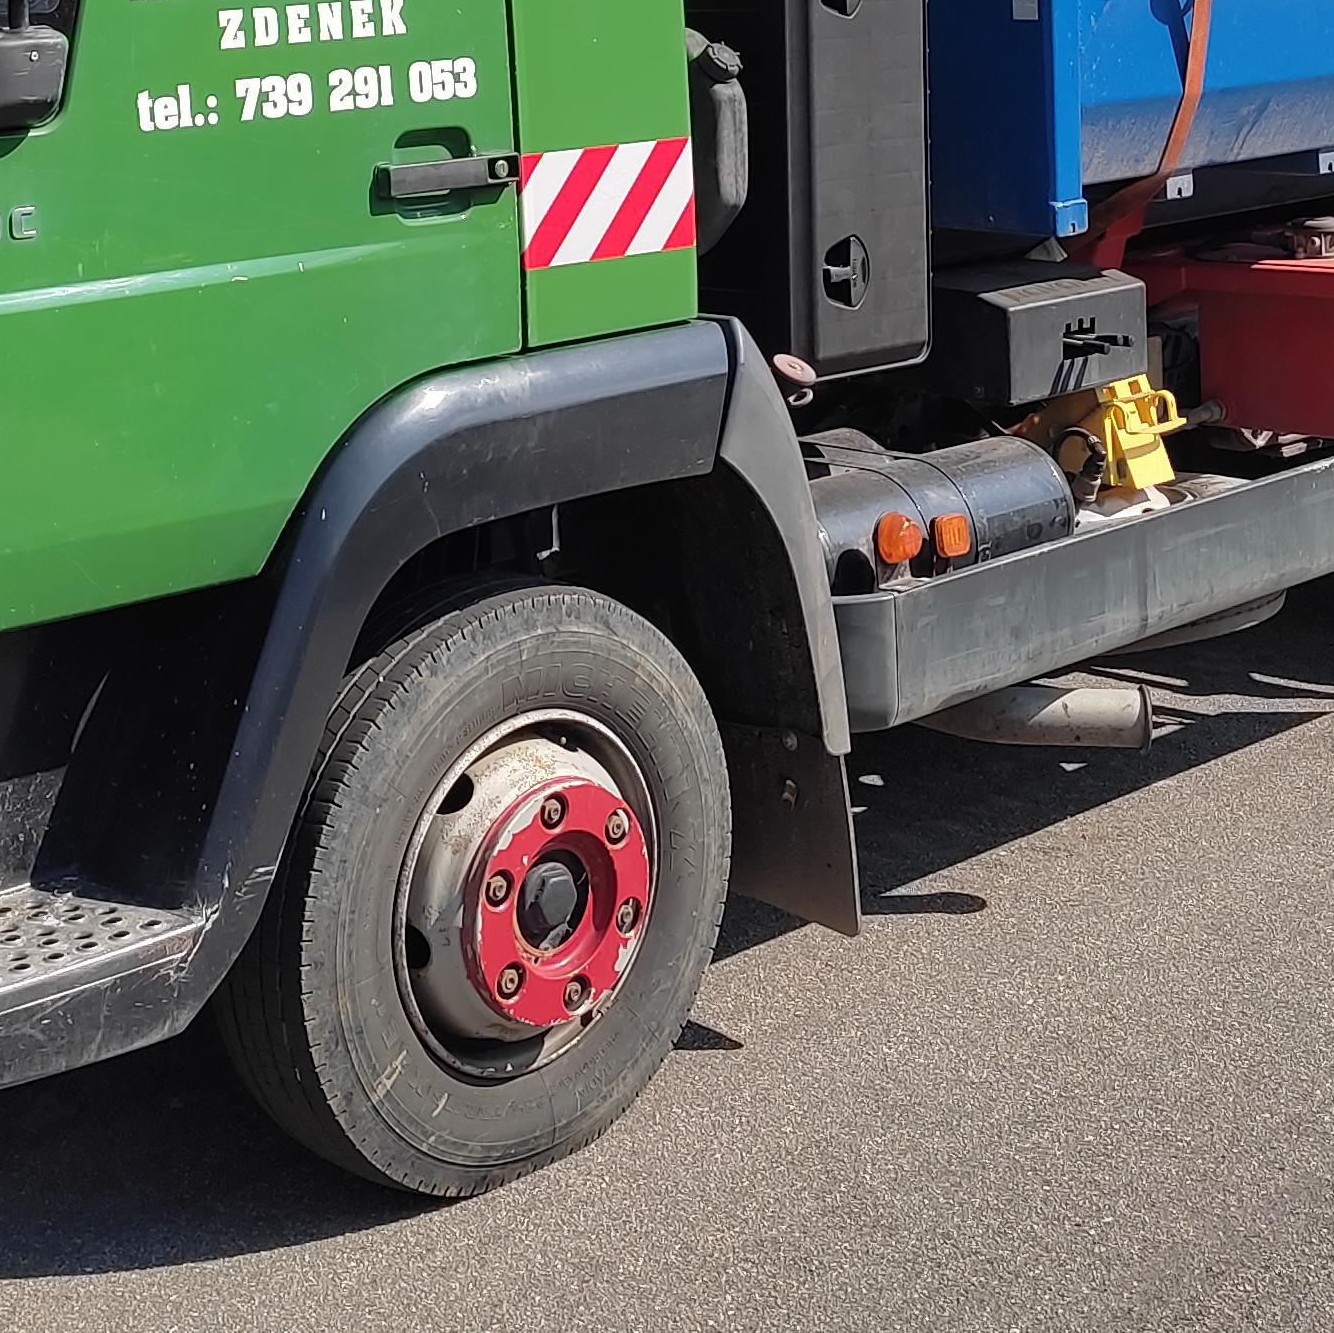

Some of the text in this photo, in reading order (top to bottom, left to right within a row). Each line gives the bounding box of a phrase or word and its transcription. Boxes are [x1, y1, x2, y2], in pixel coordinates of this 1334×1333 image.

[137, 57, 479, 132] tel.: 739 291 053
